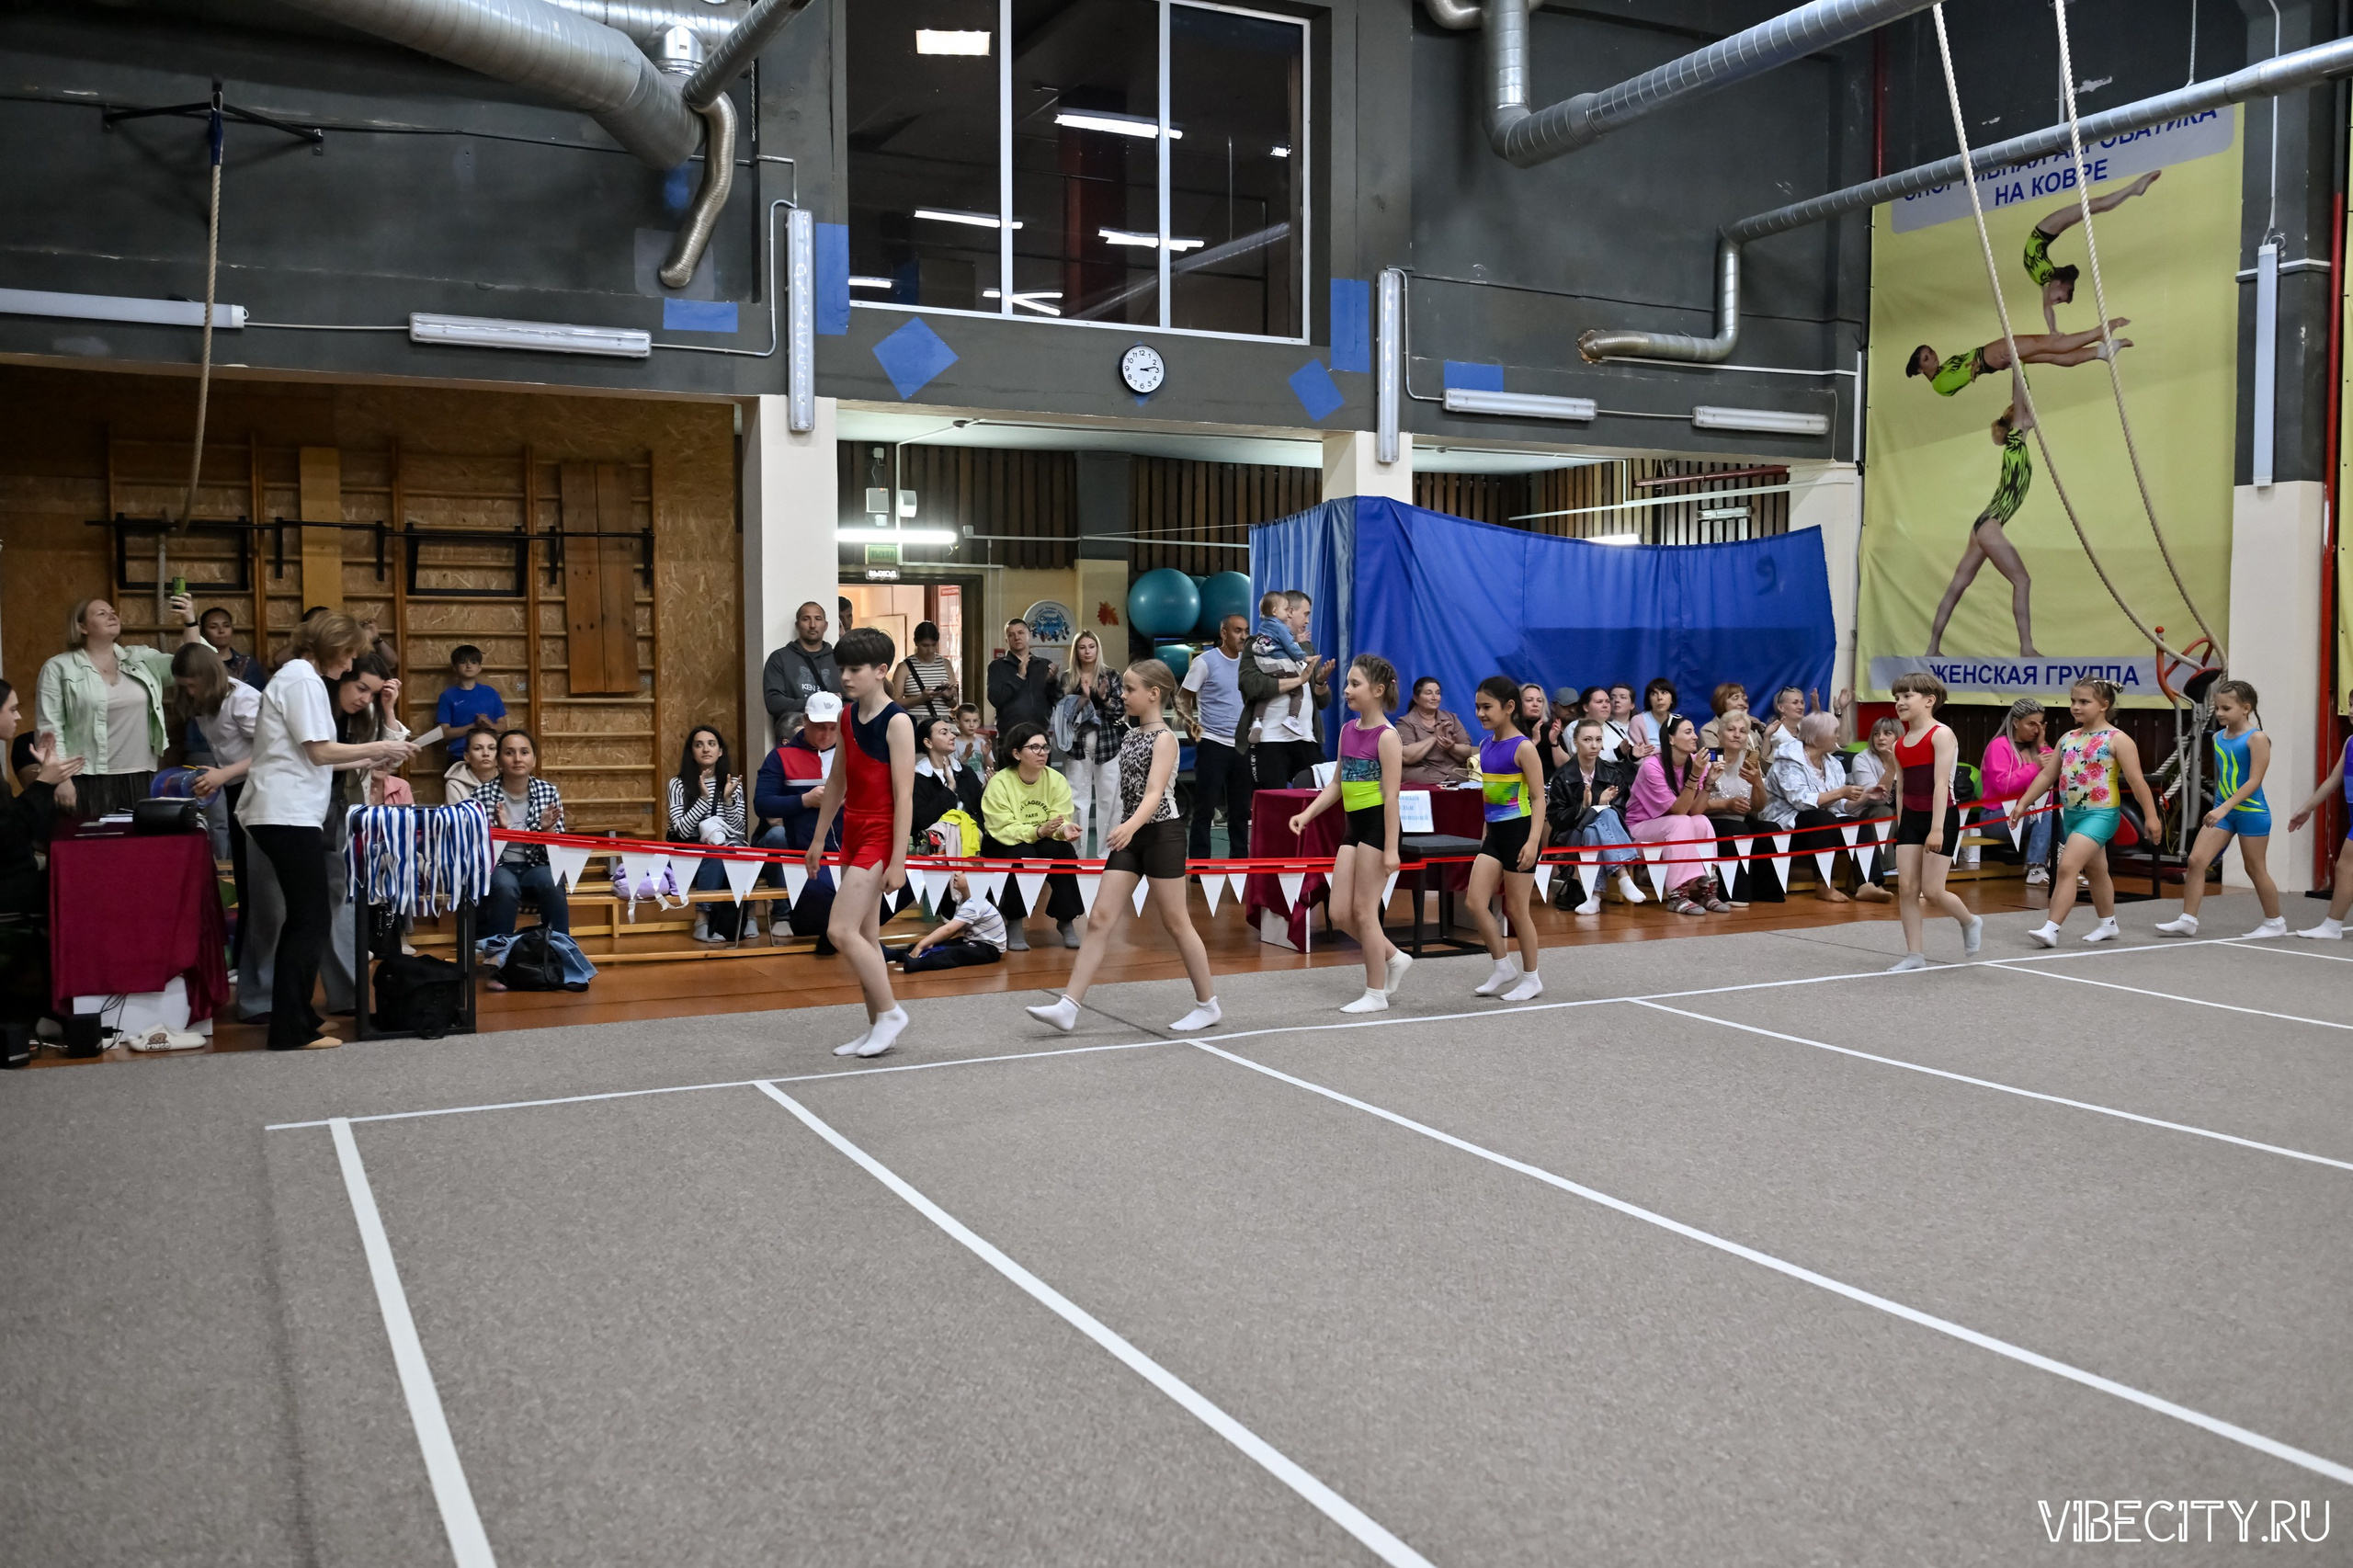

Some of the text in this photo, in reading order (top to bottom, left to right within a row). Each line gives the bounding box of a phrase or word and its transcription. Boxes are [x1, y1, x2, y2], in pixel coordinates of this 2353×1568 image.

[1995, 158, 2109, 206] НА КОВРЕ
[868, 569, 898, 579] ВЫХОД
[1929, 665, 2140, 686] ЖЕНСКАЯ ГРУППА
